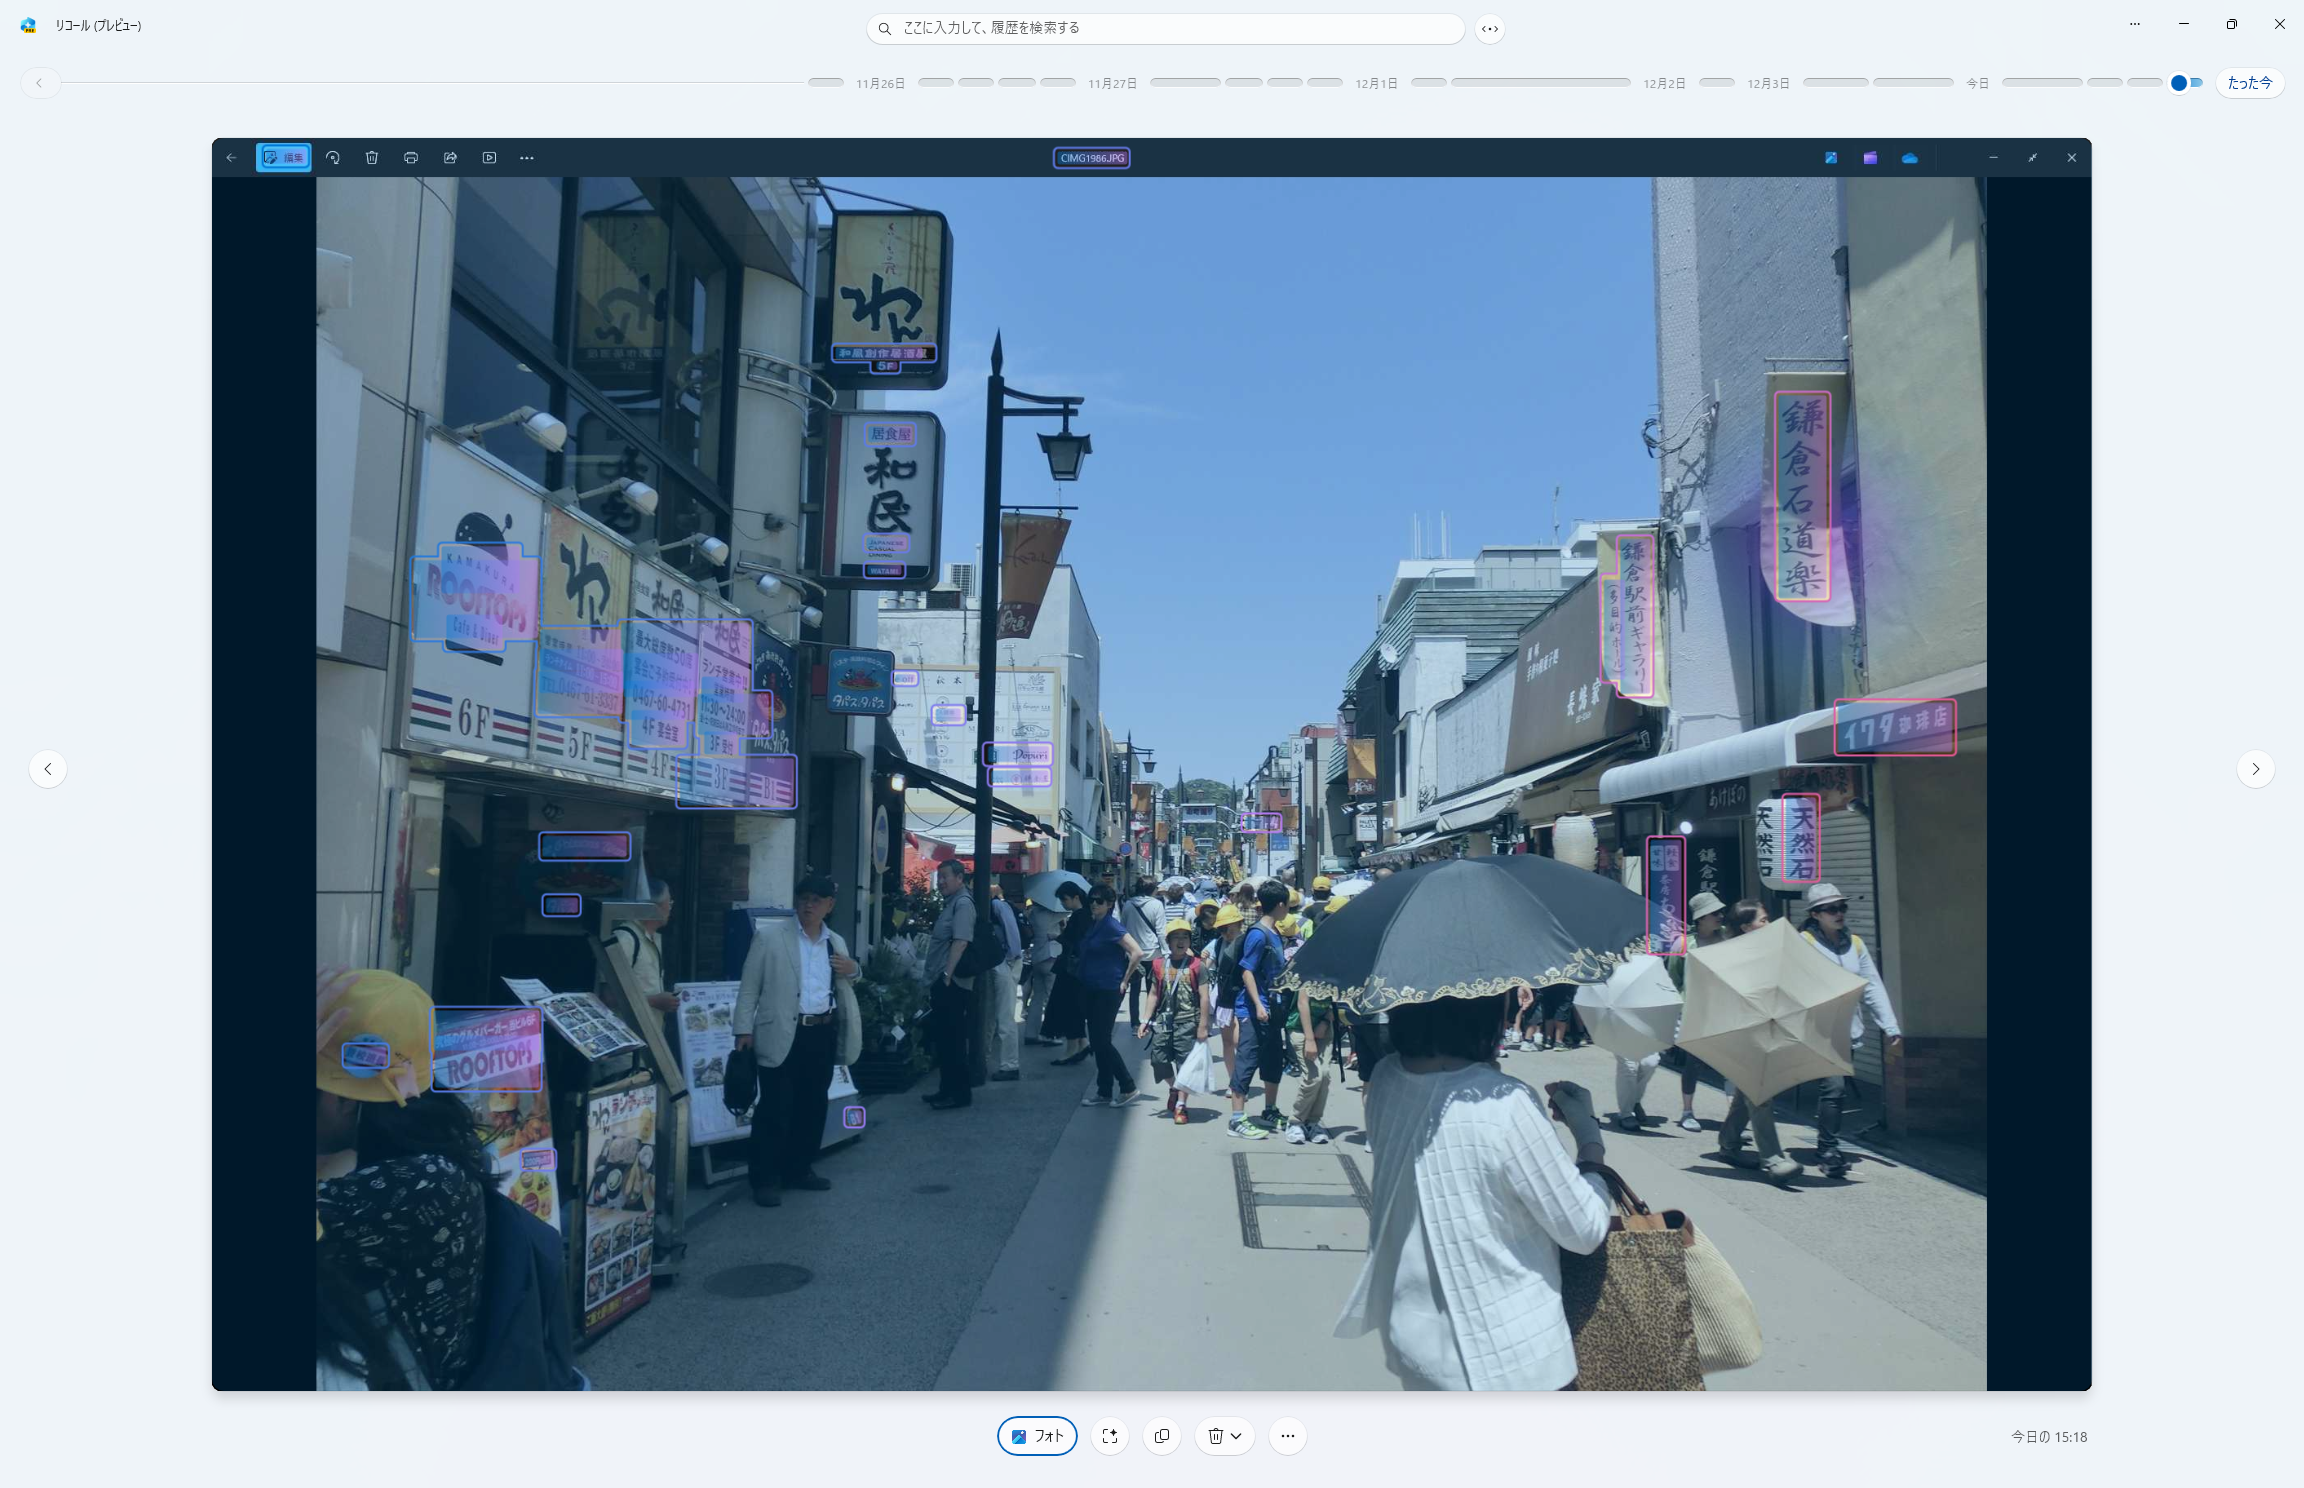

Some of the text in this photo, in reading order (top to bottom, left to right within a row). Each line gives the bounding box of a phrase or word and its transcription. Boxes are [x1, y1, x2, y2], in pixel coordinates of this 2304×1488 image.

[56, 17, 142, 33] リコール (プレビュー)
[904, 20, 1080, 35] ここに入力して、履歴を検索する
[856, 77, 905, 90] 11月26日
[1088, 77, 1137, 90] 11月27日
[1355, 77, 1398, 90] 12月1日
[1643, 77, 1686, 90] 12月2日
[1747, 77, 1790, 90] 12月3日
[1966, 77, 1989, 90] 今日
[2228, 75, 2274, 91] たった今
[284, 151, 304, 164] 編集
[839, 272, 923, 344] わん
[838, 346, 927, 359] 和風創作居酒屋
[877, 361, 894, 371] 5F
[871, 427, 911, 441] 居食屋
[863, 446, 917, 534] 和民
[1781, 399, 1826, 597] 鎌倉石道楽
[447, 553, 515, 593] KAMAKURA
[870, 567, 899, 575] WATAMI
[426, 562, 527, 633] ROOFTOPS
[559, 533, 610, 644] わん
[453, 616, 470, 635] Cafe
[1620, 541, 1647, 694] 鎌倉駅前ギャラリー
[632, 685, 691, 721] 0467-60-4731
[458, 698, 490, 739] 6F
[642, 715, 655, 736] 4F
[568, 725, 592, 761] 5F
[709, 735, 720, 751] 3F
[651, 750, 669, 779] 4F
[714, 764, 729, 790] 3F
[1709, 784, 1747, 809] あけぼの
[1756, 806, 1774, 878] 天然石
[1789, 806, 1816, 880] 天然石
[446, 1039, 533, 1086] ROOFTOPS
[1034, 1428, 1064, 1443] フォト
[2010, 1429, 2088, 1444] 今日の 15:18
